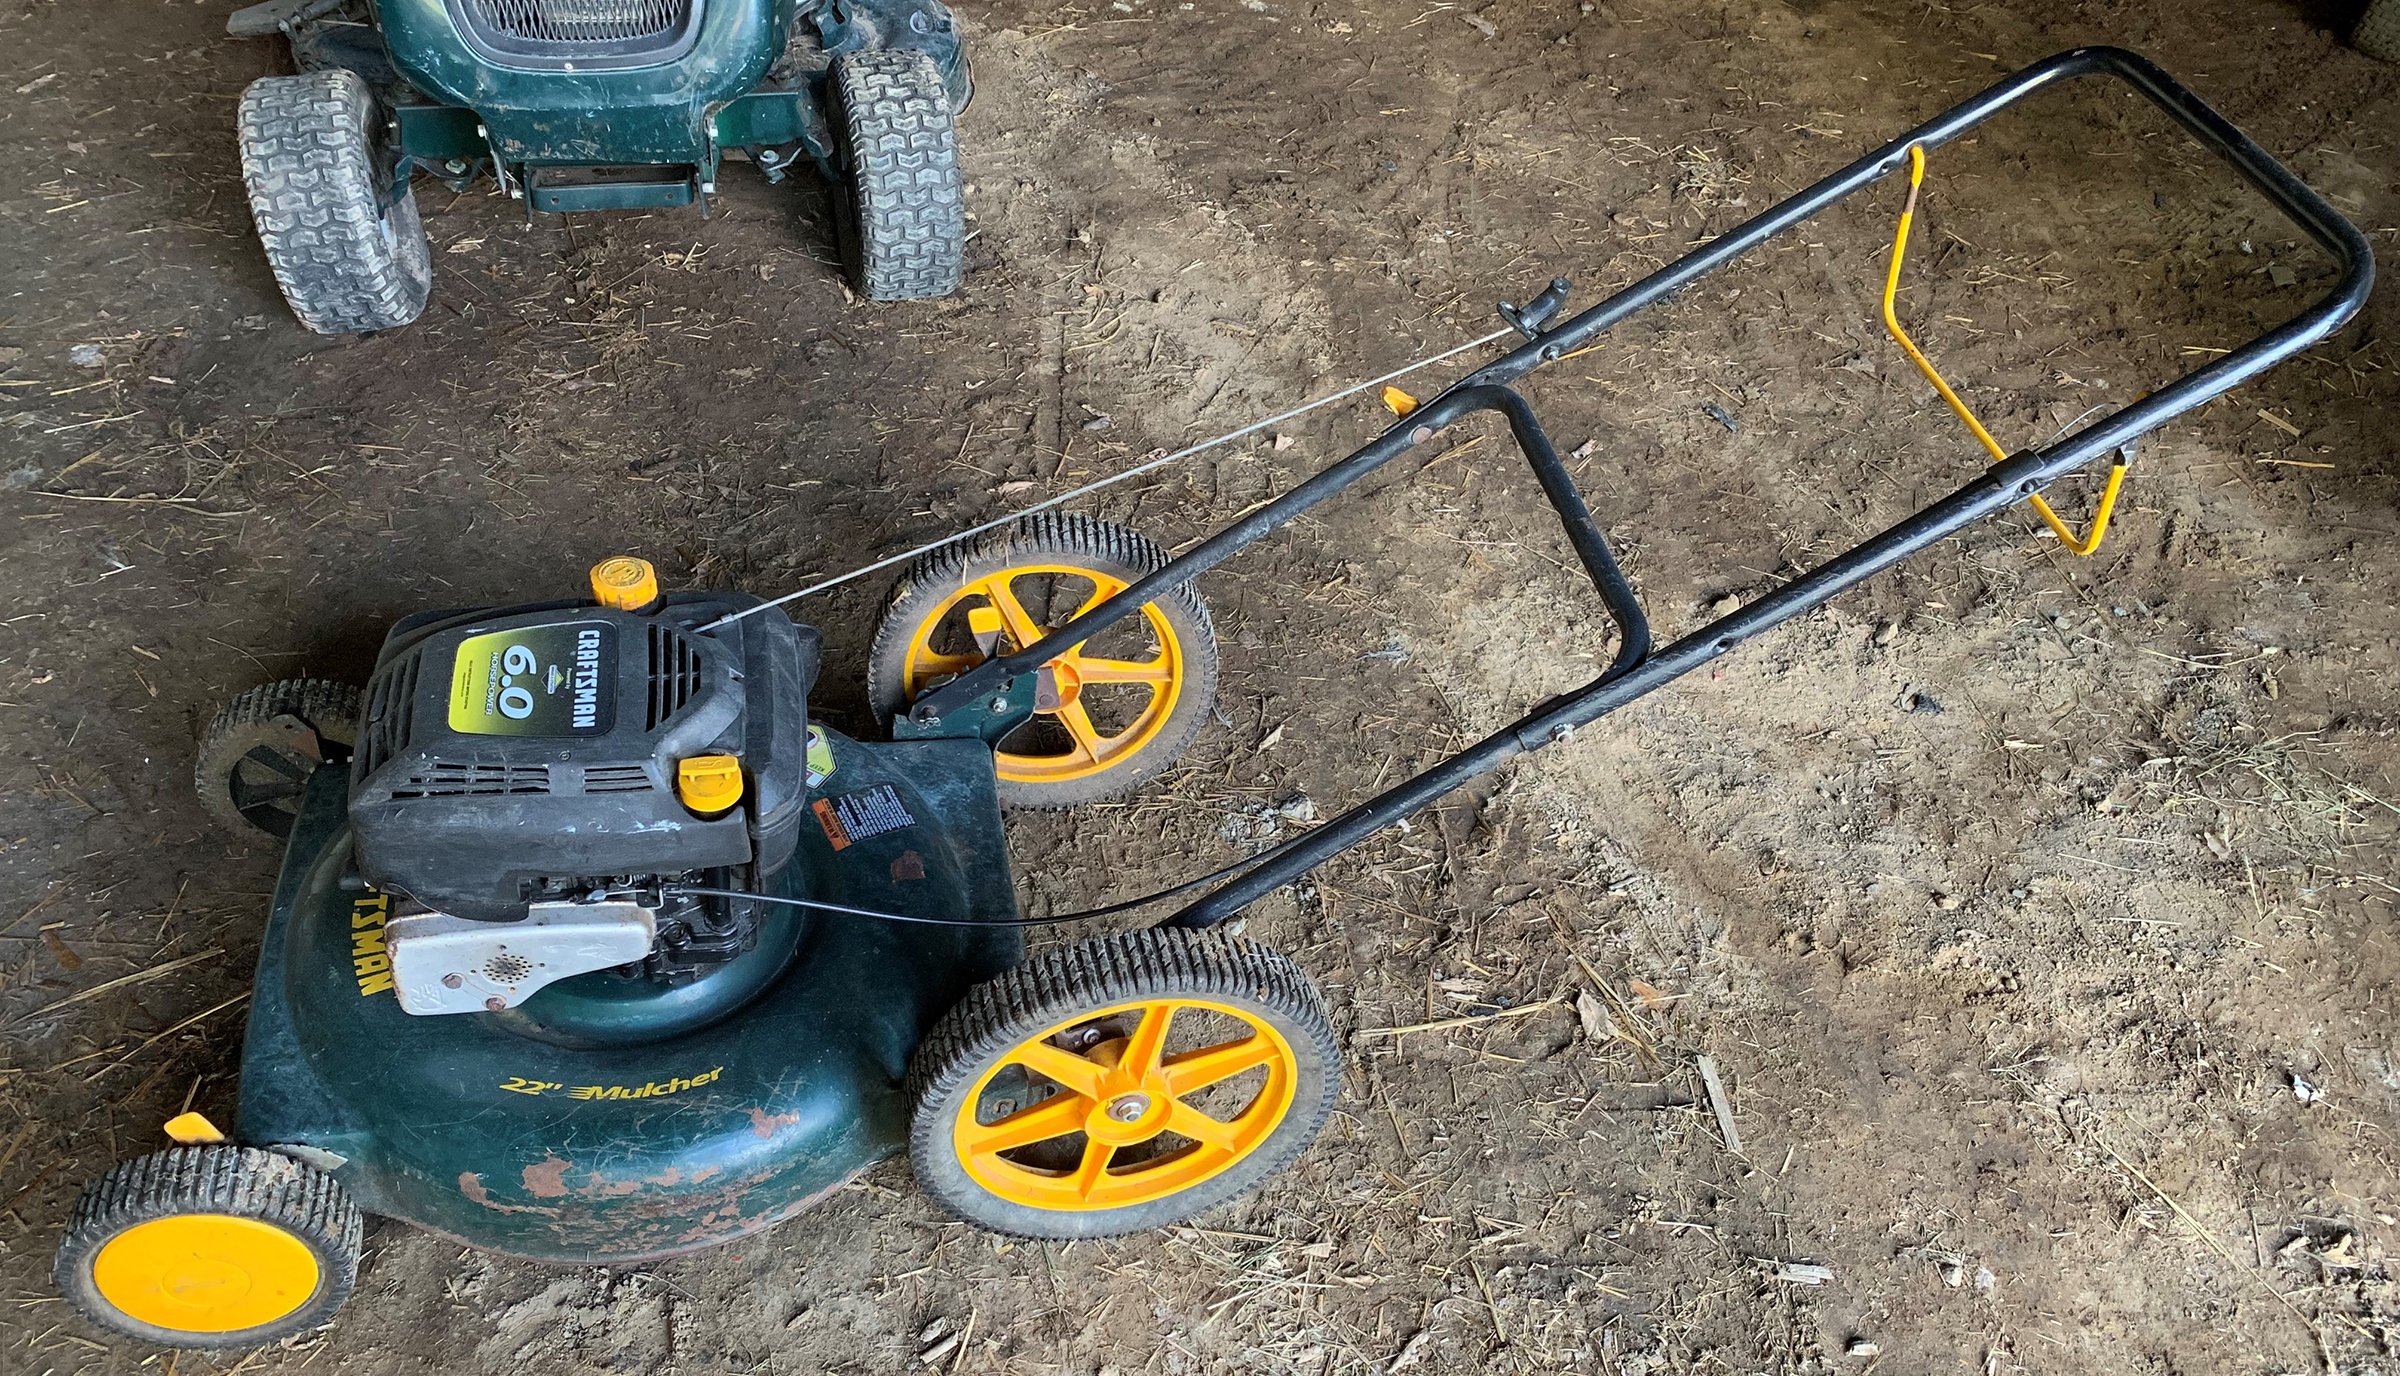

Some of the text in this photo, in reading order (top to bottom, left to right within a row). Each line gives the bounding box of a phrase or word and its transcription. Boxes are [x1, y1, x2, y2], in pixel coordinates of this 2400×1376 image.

[484, 651, 500, 717] HORSEPOWER
[499, 644, 537, 720] 6.0
[572, 629, 600, 728] CRAFTSMAN
[351, 887, 394, 997] TSMAN
[499, 1066, 723, 1100] 22" Mulcher
